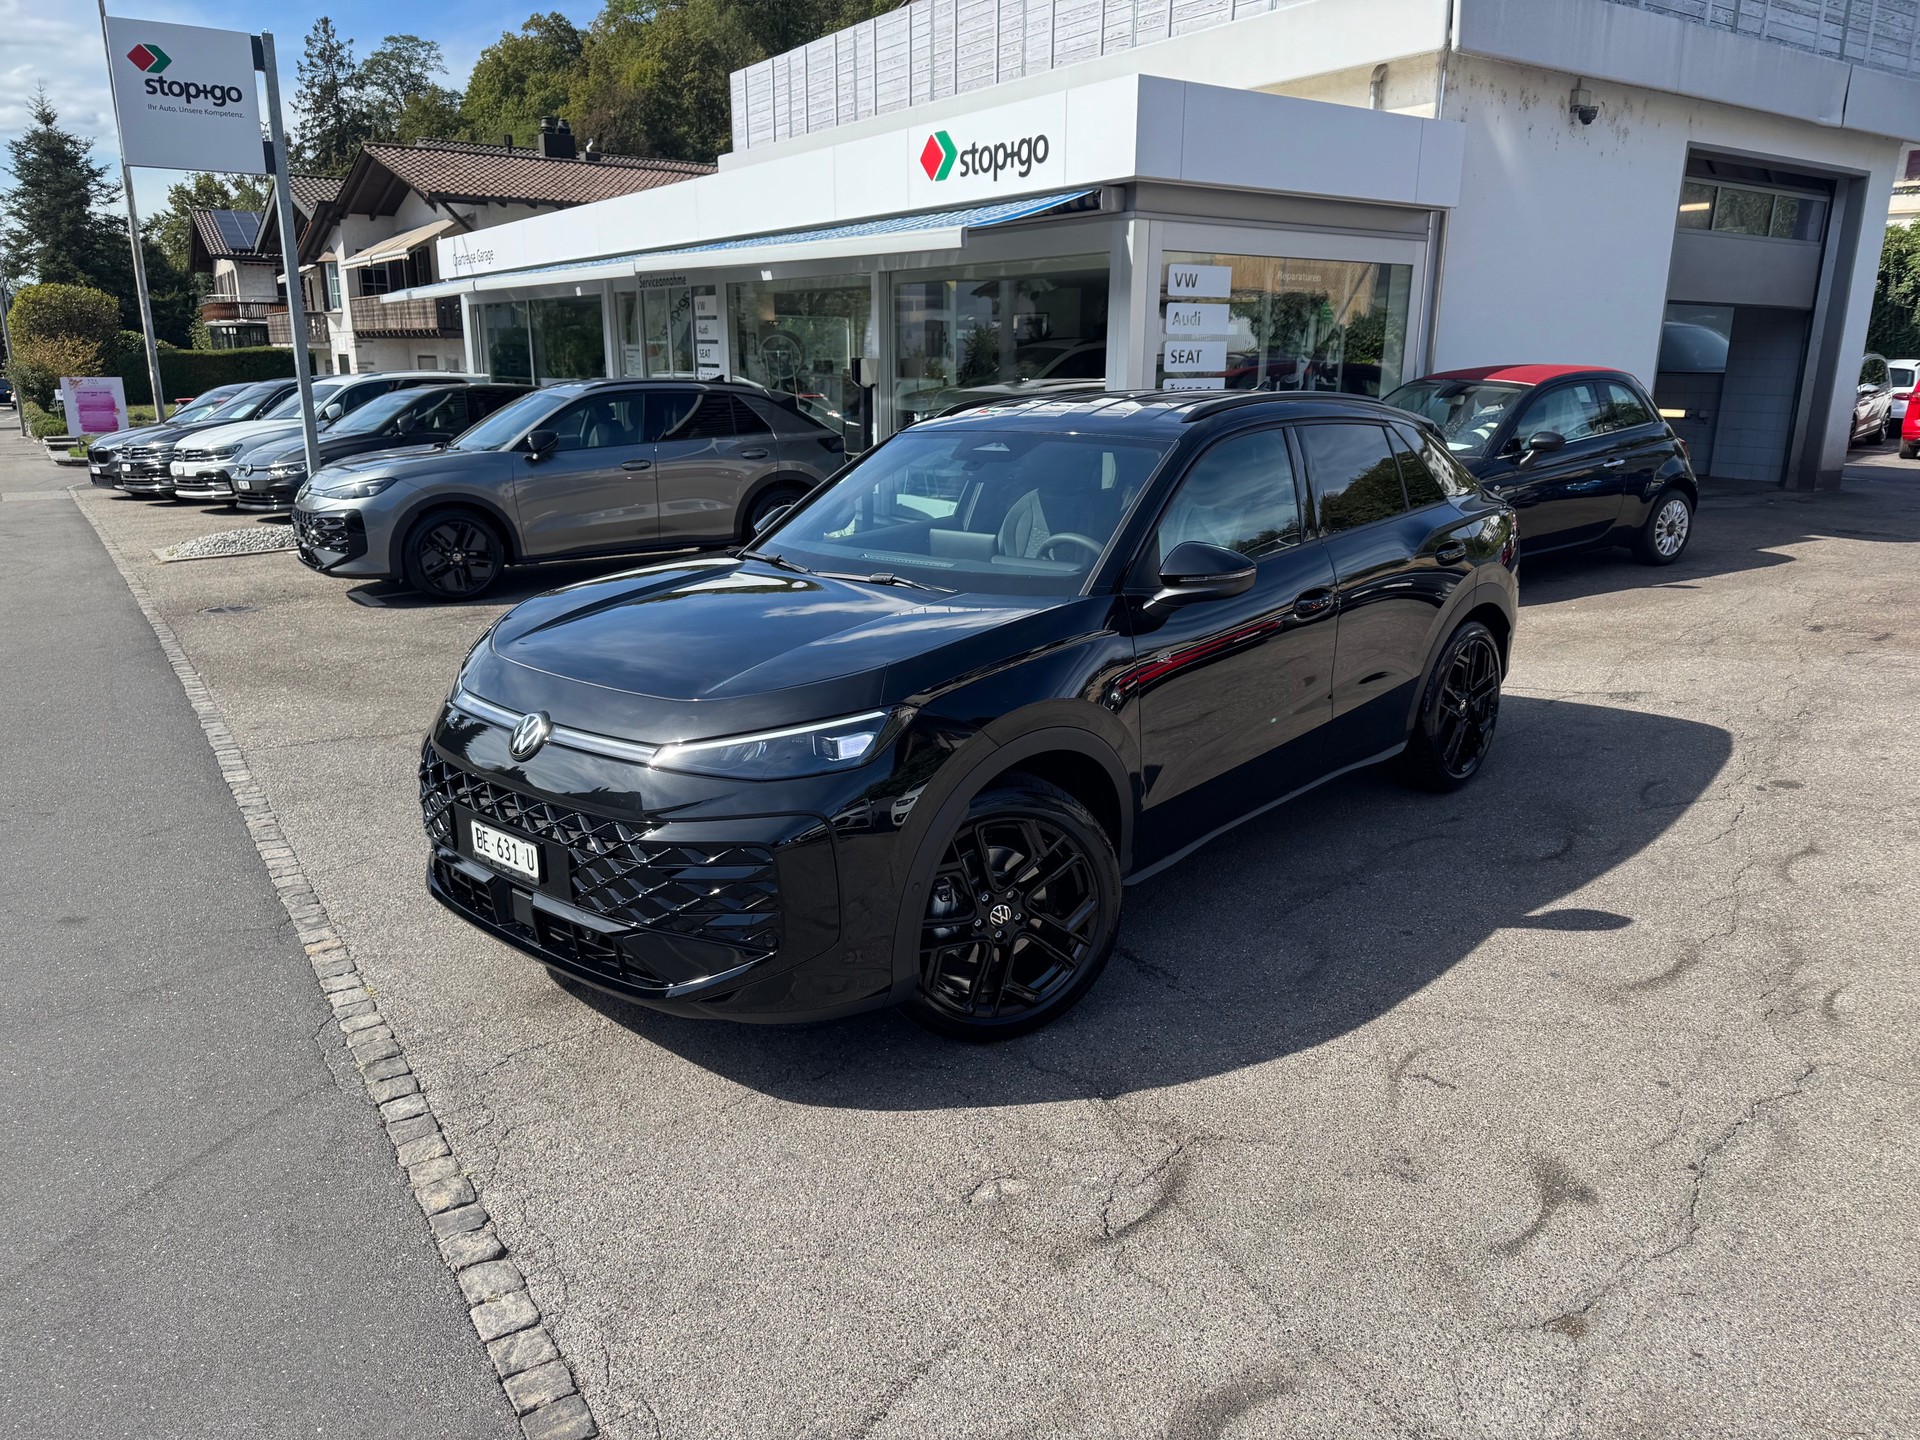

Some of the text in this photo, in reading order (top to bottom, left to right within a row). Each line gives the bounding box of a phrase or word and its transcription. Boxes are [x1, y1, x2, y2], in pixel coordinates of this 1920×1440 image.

[144, 75, 243, 107] stop+go
[159, 104, 178, 112] Auto.
[178, 106, 203, 115] Unsere
[204, 108, 245, 118] Kompetenz.
[960, 134, 1049, 182] stop+go
[476, 249, 494, 265] Garage
[639, 272, 686, 288] Serviceannahme
[1174, 272, 1198, 288] VW
[1277, 270, 1322, 282] Reparaturen
[1171, 311, 1201, 326] Audi
[699, 348, 711, 359] SEAT
[1170, 349, 1202, 364] SEAT
